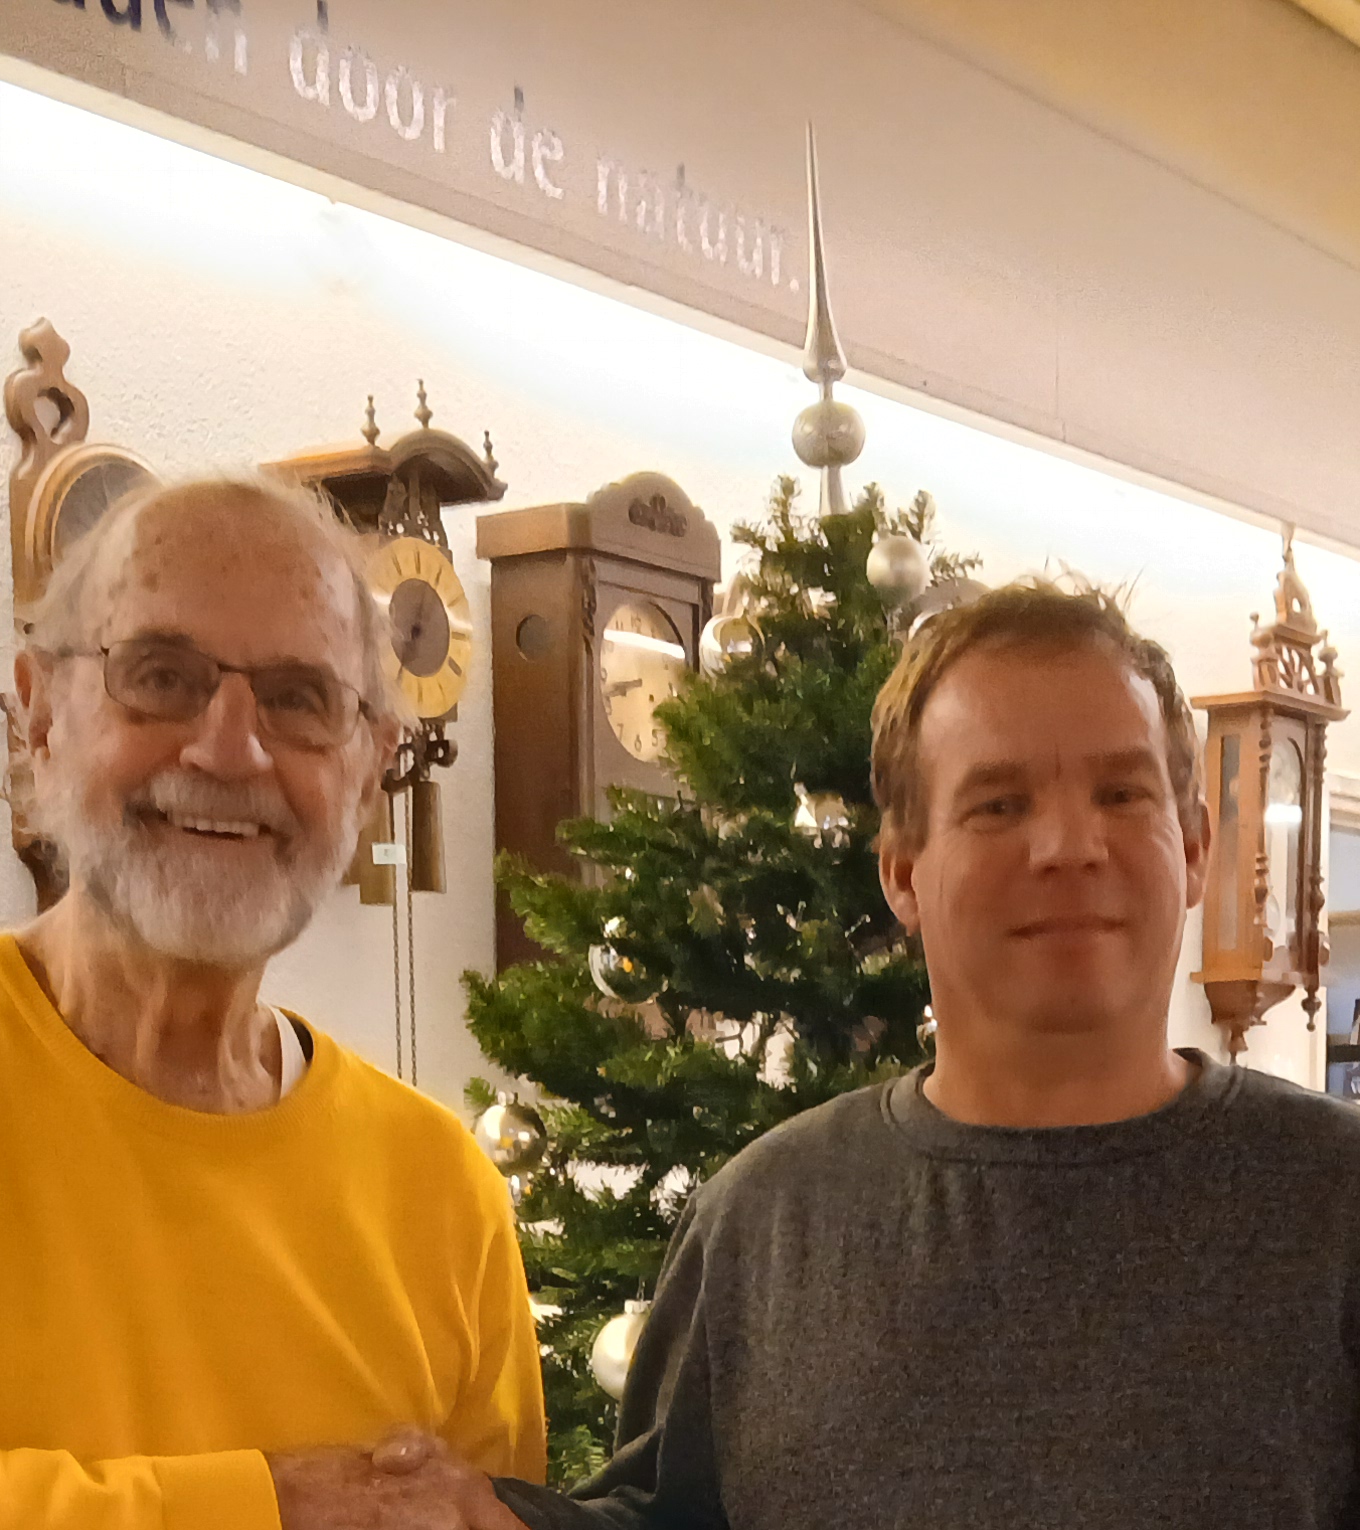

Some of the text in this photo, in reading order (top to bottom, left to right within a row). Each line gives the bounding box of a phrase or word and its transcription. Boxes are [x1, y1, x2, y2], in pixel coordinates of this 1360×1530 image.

[289, 0, 456, 153] door
[491, 86, 564, 200] de
[597, 155, 800, 291] natuur.
